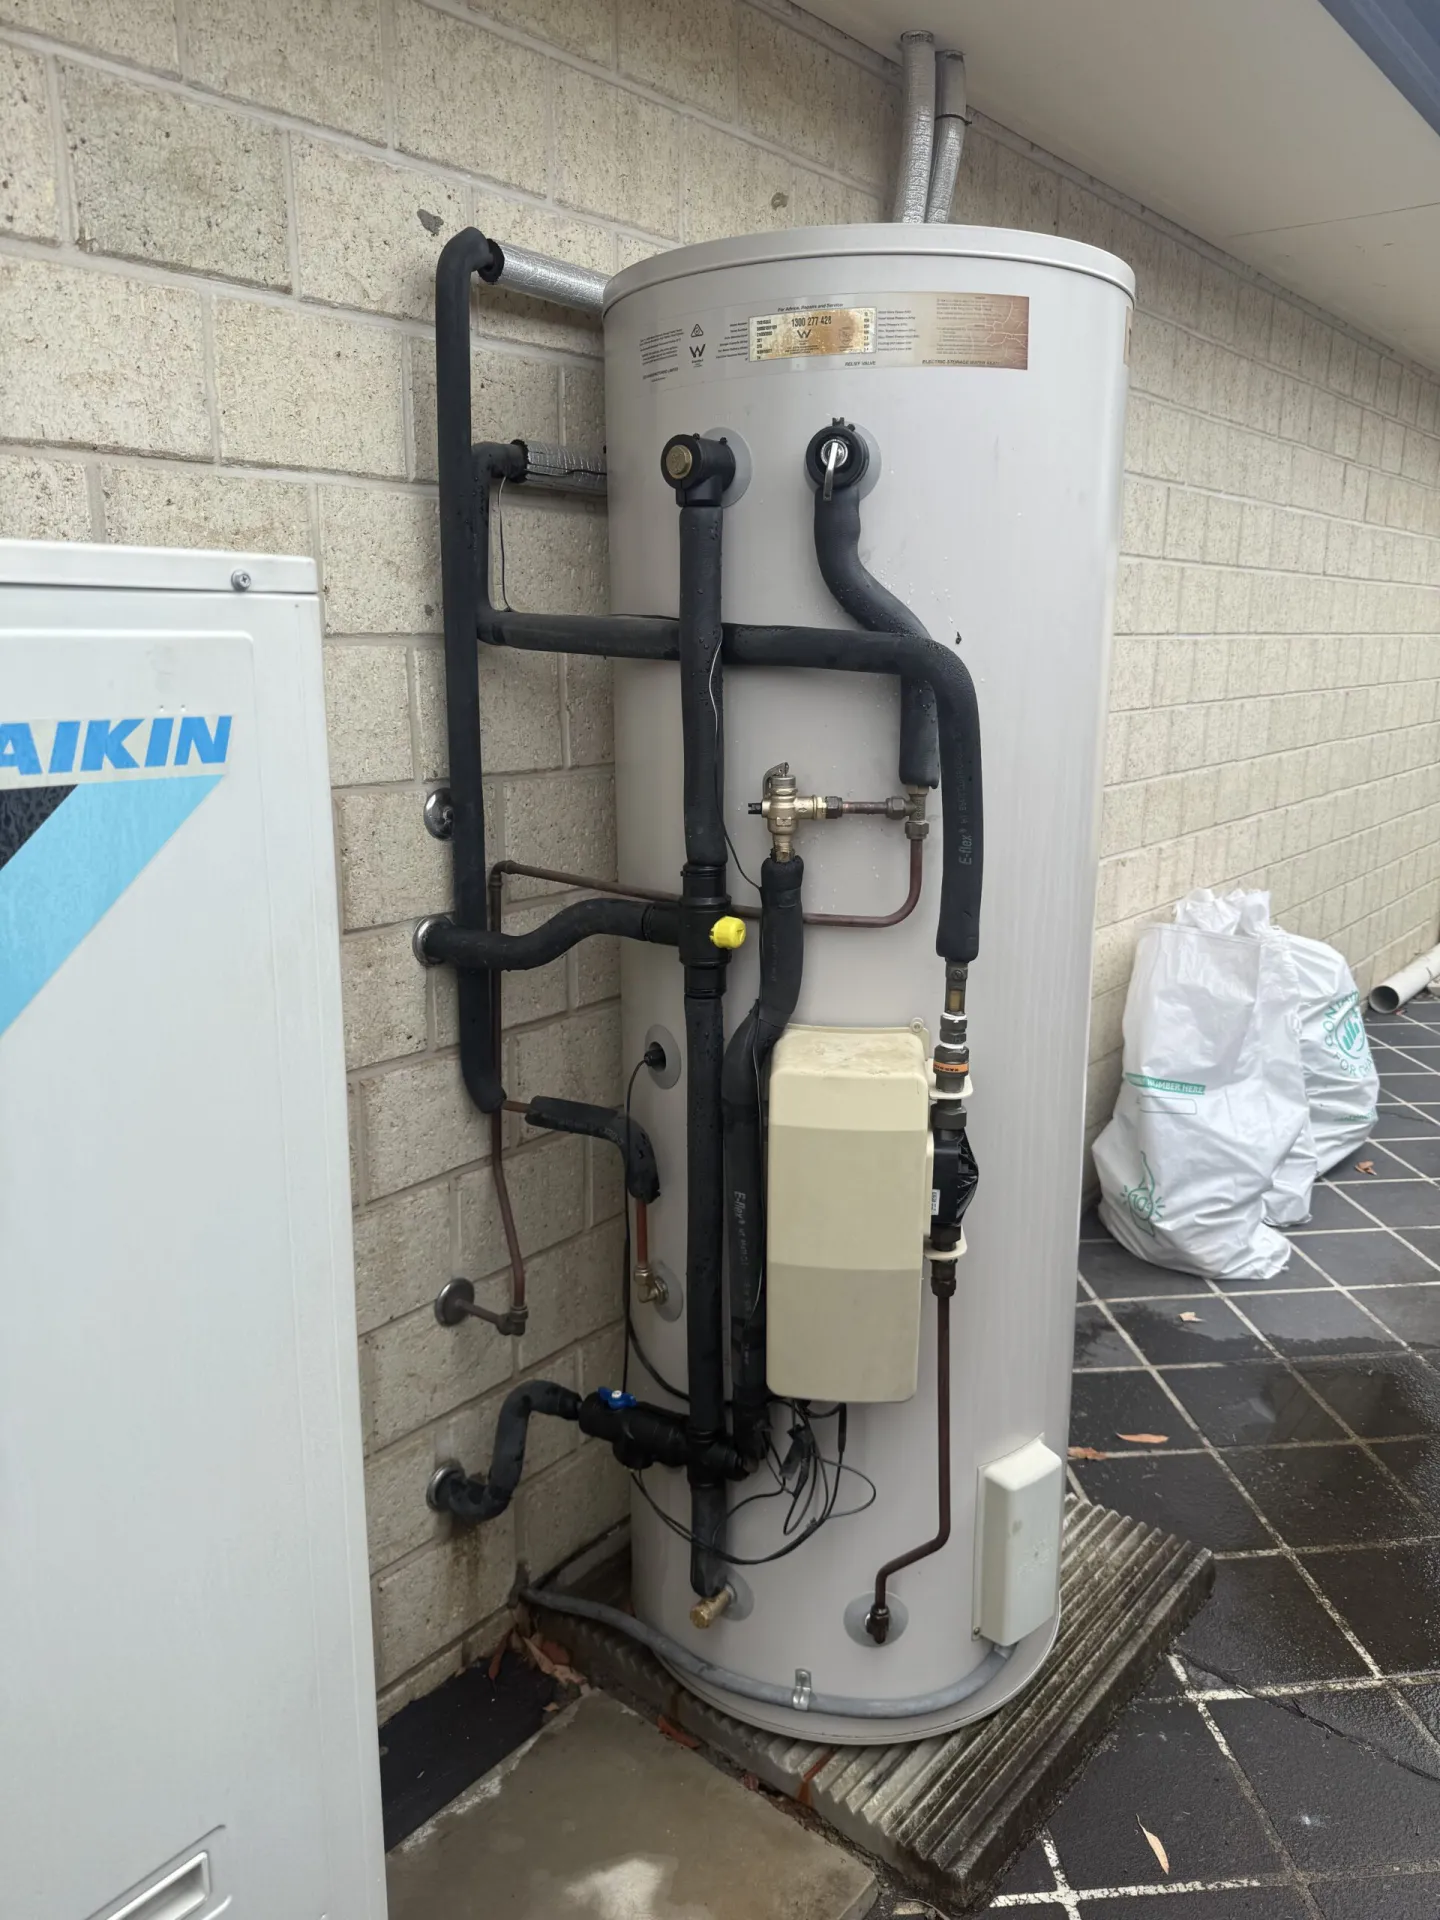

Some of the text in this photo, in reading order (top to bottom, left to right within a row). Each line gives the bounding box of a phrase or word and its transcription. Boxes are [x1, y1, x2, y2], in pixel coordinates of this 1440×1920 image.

[791, 316, 832, 327] 1300 277 428
[1147, 1078, 1181, 1091] NUMBER
[1182, 1085, 1203, 1093] HERE
